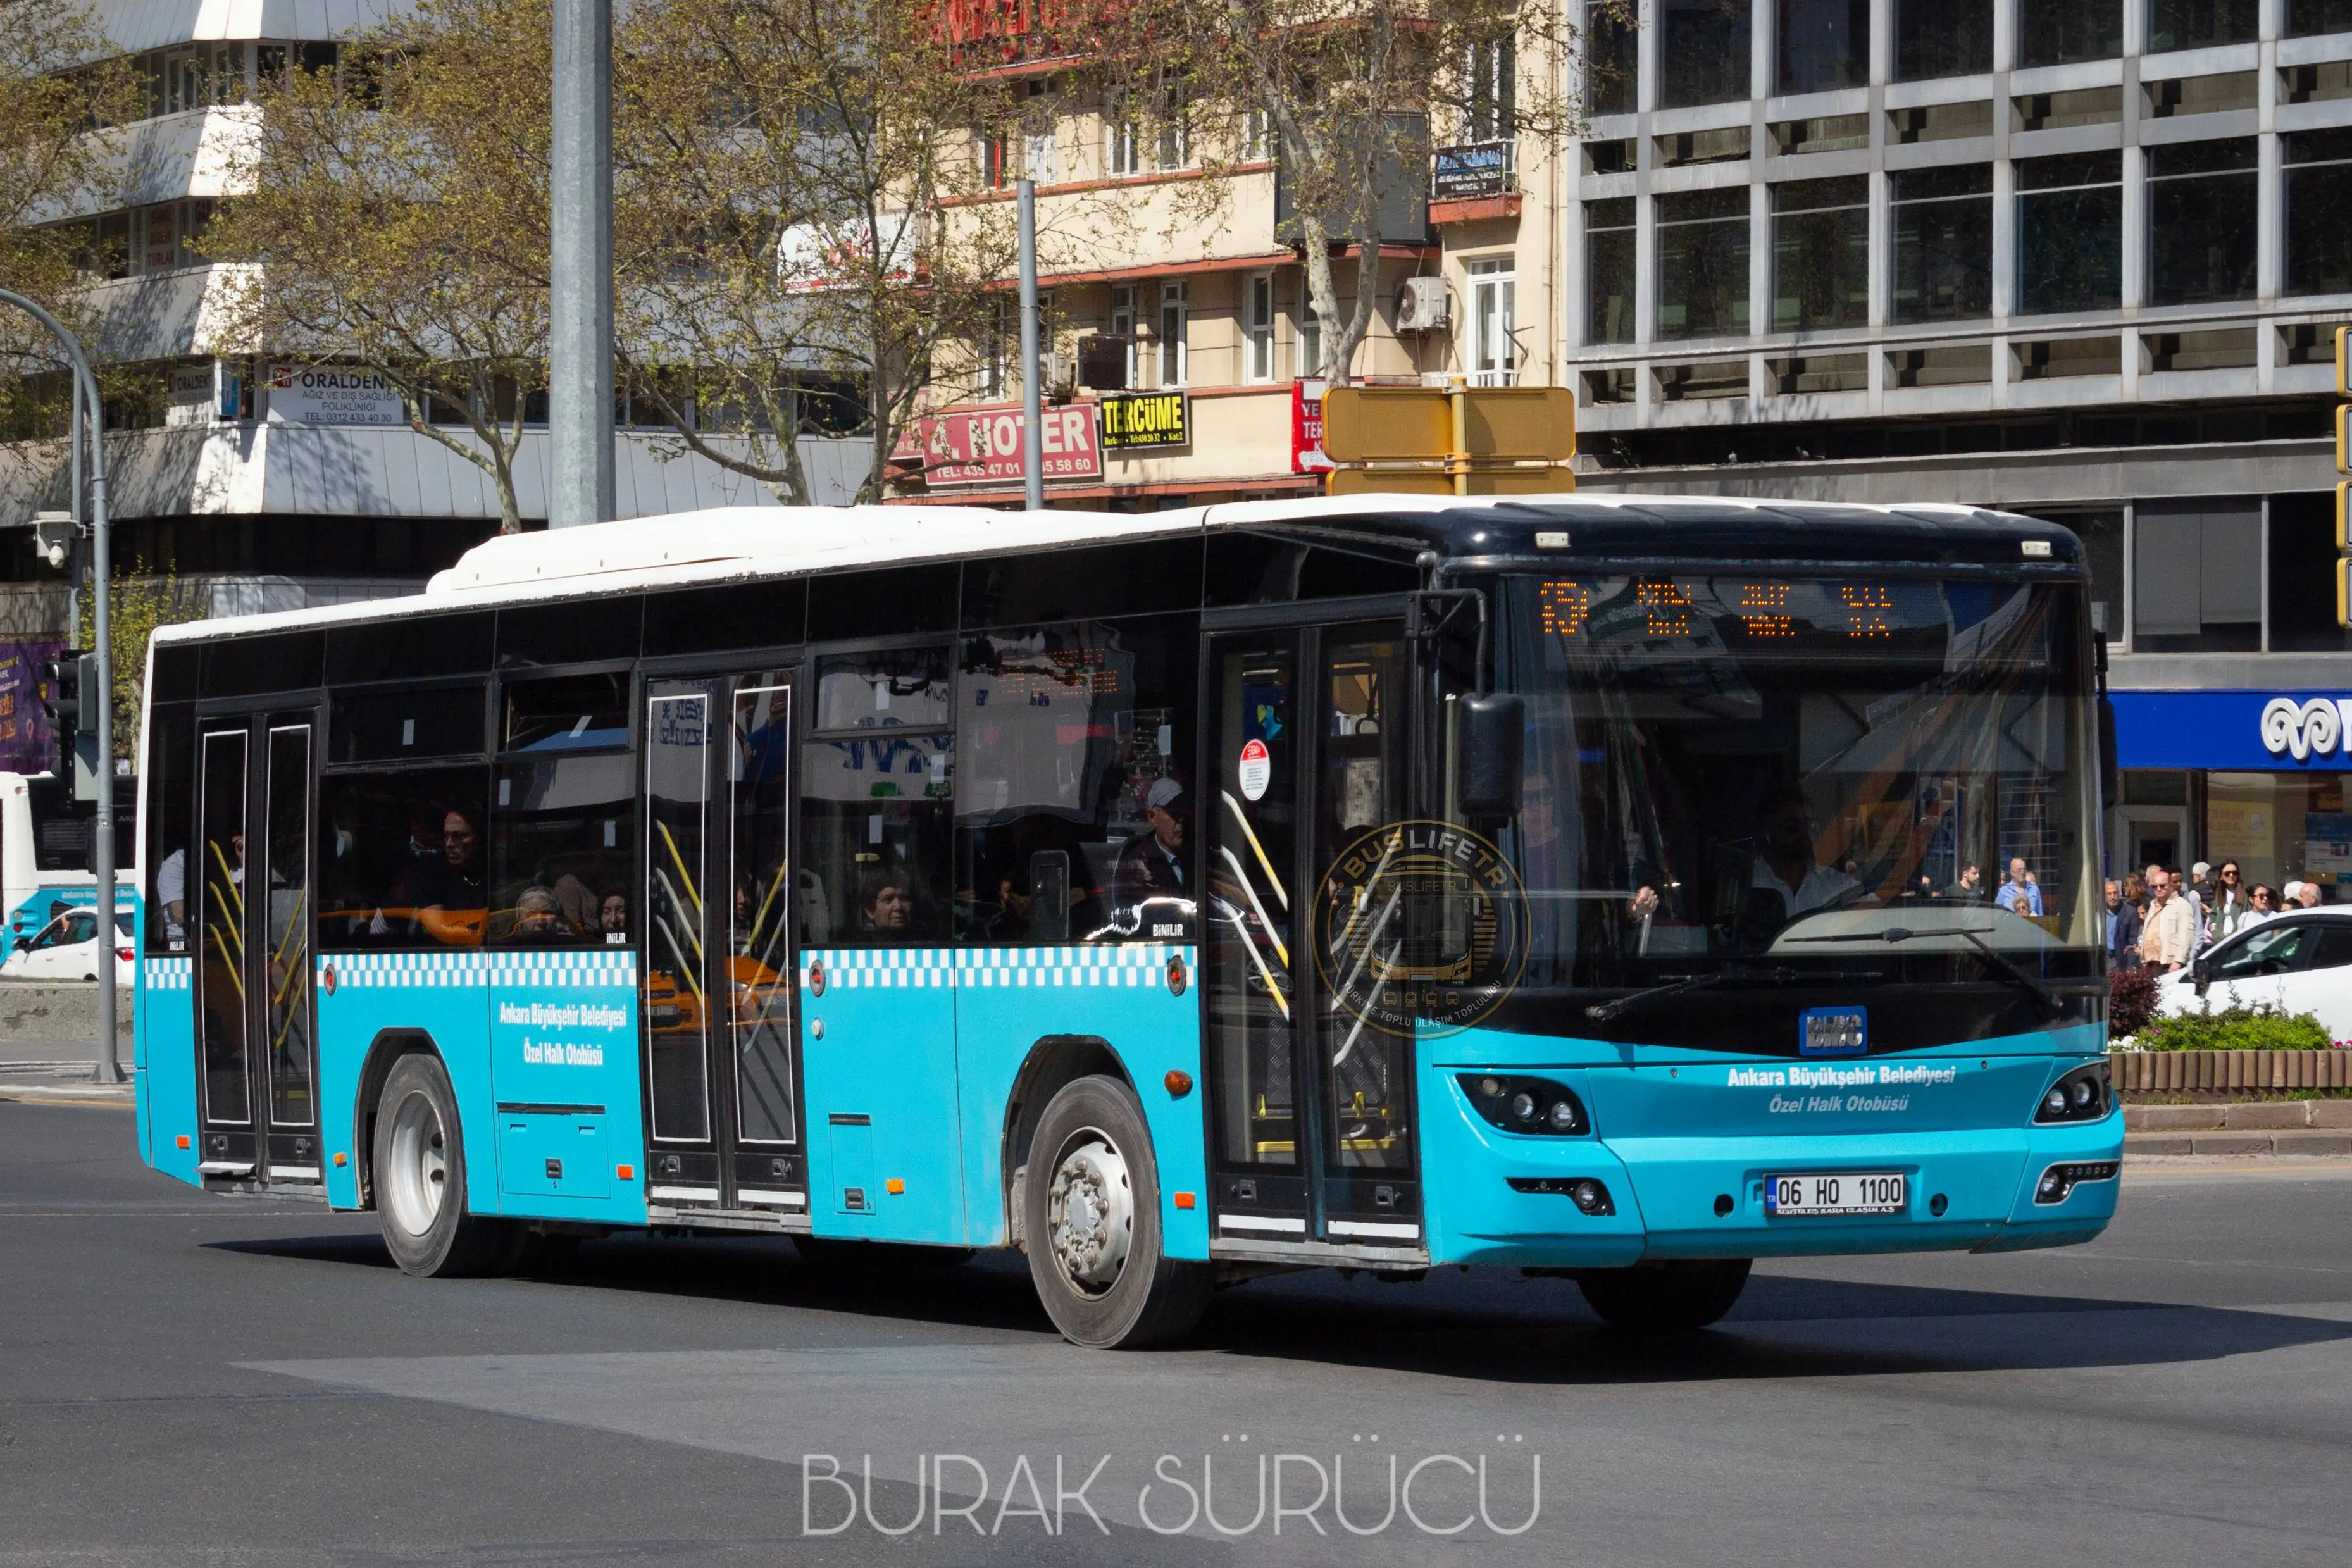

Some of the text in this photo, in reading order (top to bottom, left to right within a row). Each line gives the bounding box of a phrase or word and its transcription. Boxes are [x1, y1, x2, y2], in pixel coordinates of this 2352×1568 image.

[302, 373, 391, 390] ORALDEN
[302, 390, 324, 399] AĞIZ
[326, 391, 339, 400] VE
[341, 390, 356, 402] DİŞ
[327, 413, 347, 421] 0312
[349, 413, 366, 421] 433
[368, 413, 379, 422] 40
[381, 413, 392, 422] 30
[936, 467, 961, 478] TEL:
[964, 464, 985, 477] 435
[988, 463, 1002, 475] 47
[1006, 462, 1020, 475] 01
[1057, 459, 1072, 472] 58
[1075, 457, 1091, 470] 60
[500, 1002, 626, 1032] Ankara Büyükşehir Belediyesi
[1806, 1014, 1863, 1048] BMC
[524, 1037, 603, 1066] Özel Halk Otobüsü
[1727, 1066, 1956, 1089] Ankara Büyükşehir Belediyesi
[1769, 1094, 1910, 1113] Özel Halk Otobüsü
[1767, 1178, 1901, 1205] TR 06 HO 1100
